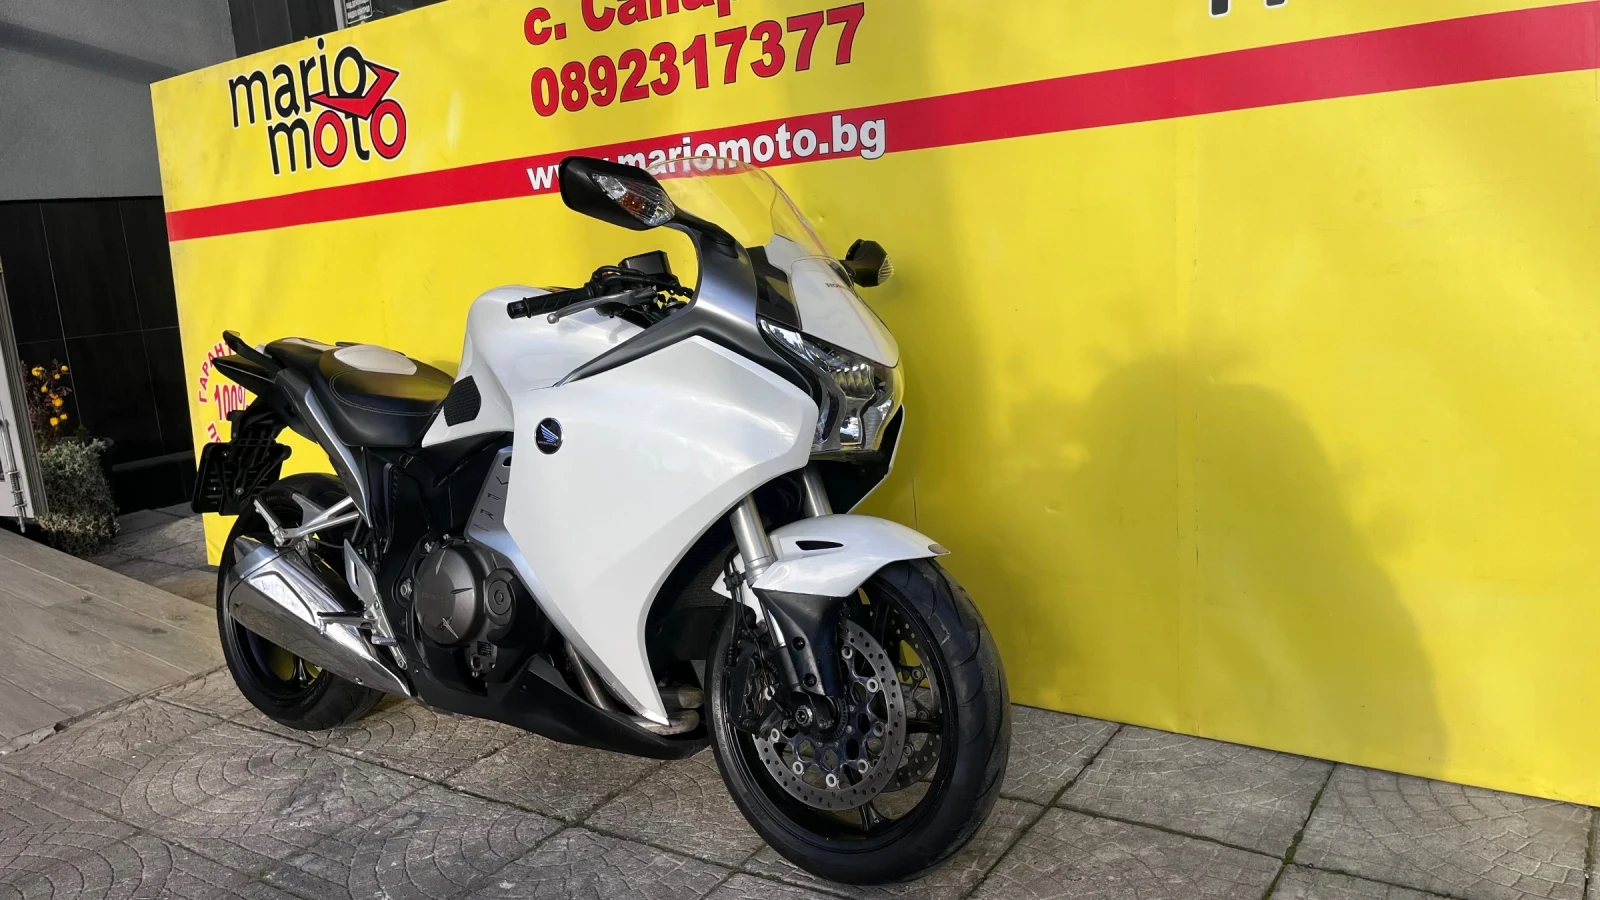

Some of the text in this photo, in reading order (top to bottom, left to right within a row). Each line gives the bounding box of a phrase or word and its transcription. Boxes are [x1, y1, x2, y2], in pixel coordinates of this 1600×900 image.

[229, 38, 366, 128] mario
[531, 2, 865, 117] 0892317377
[267, 99, 407, 175] moto
